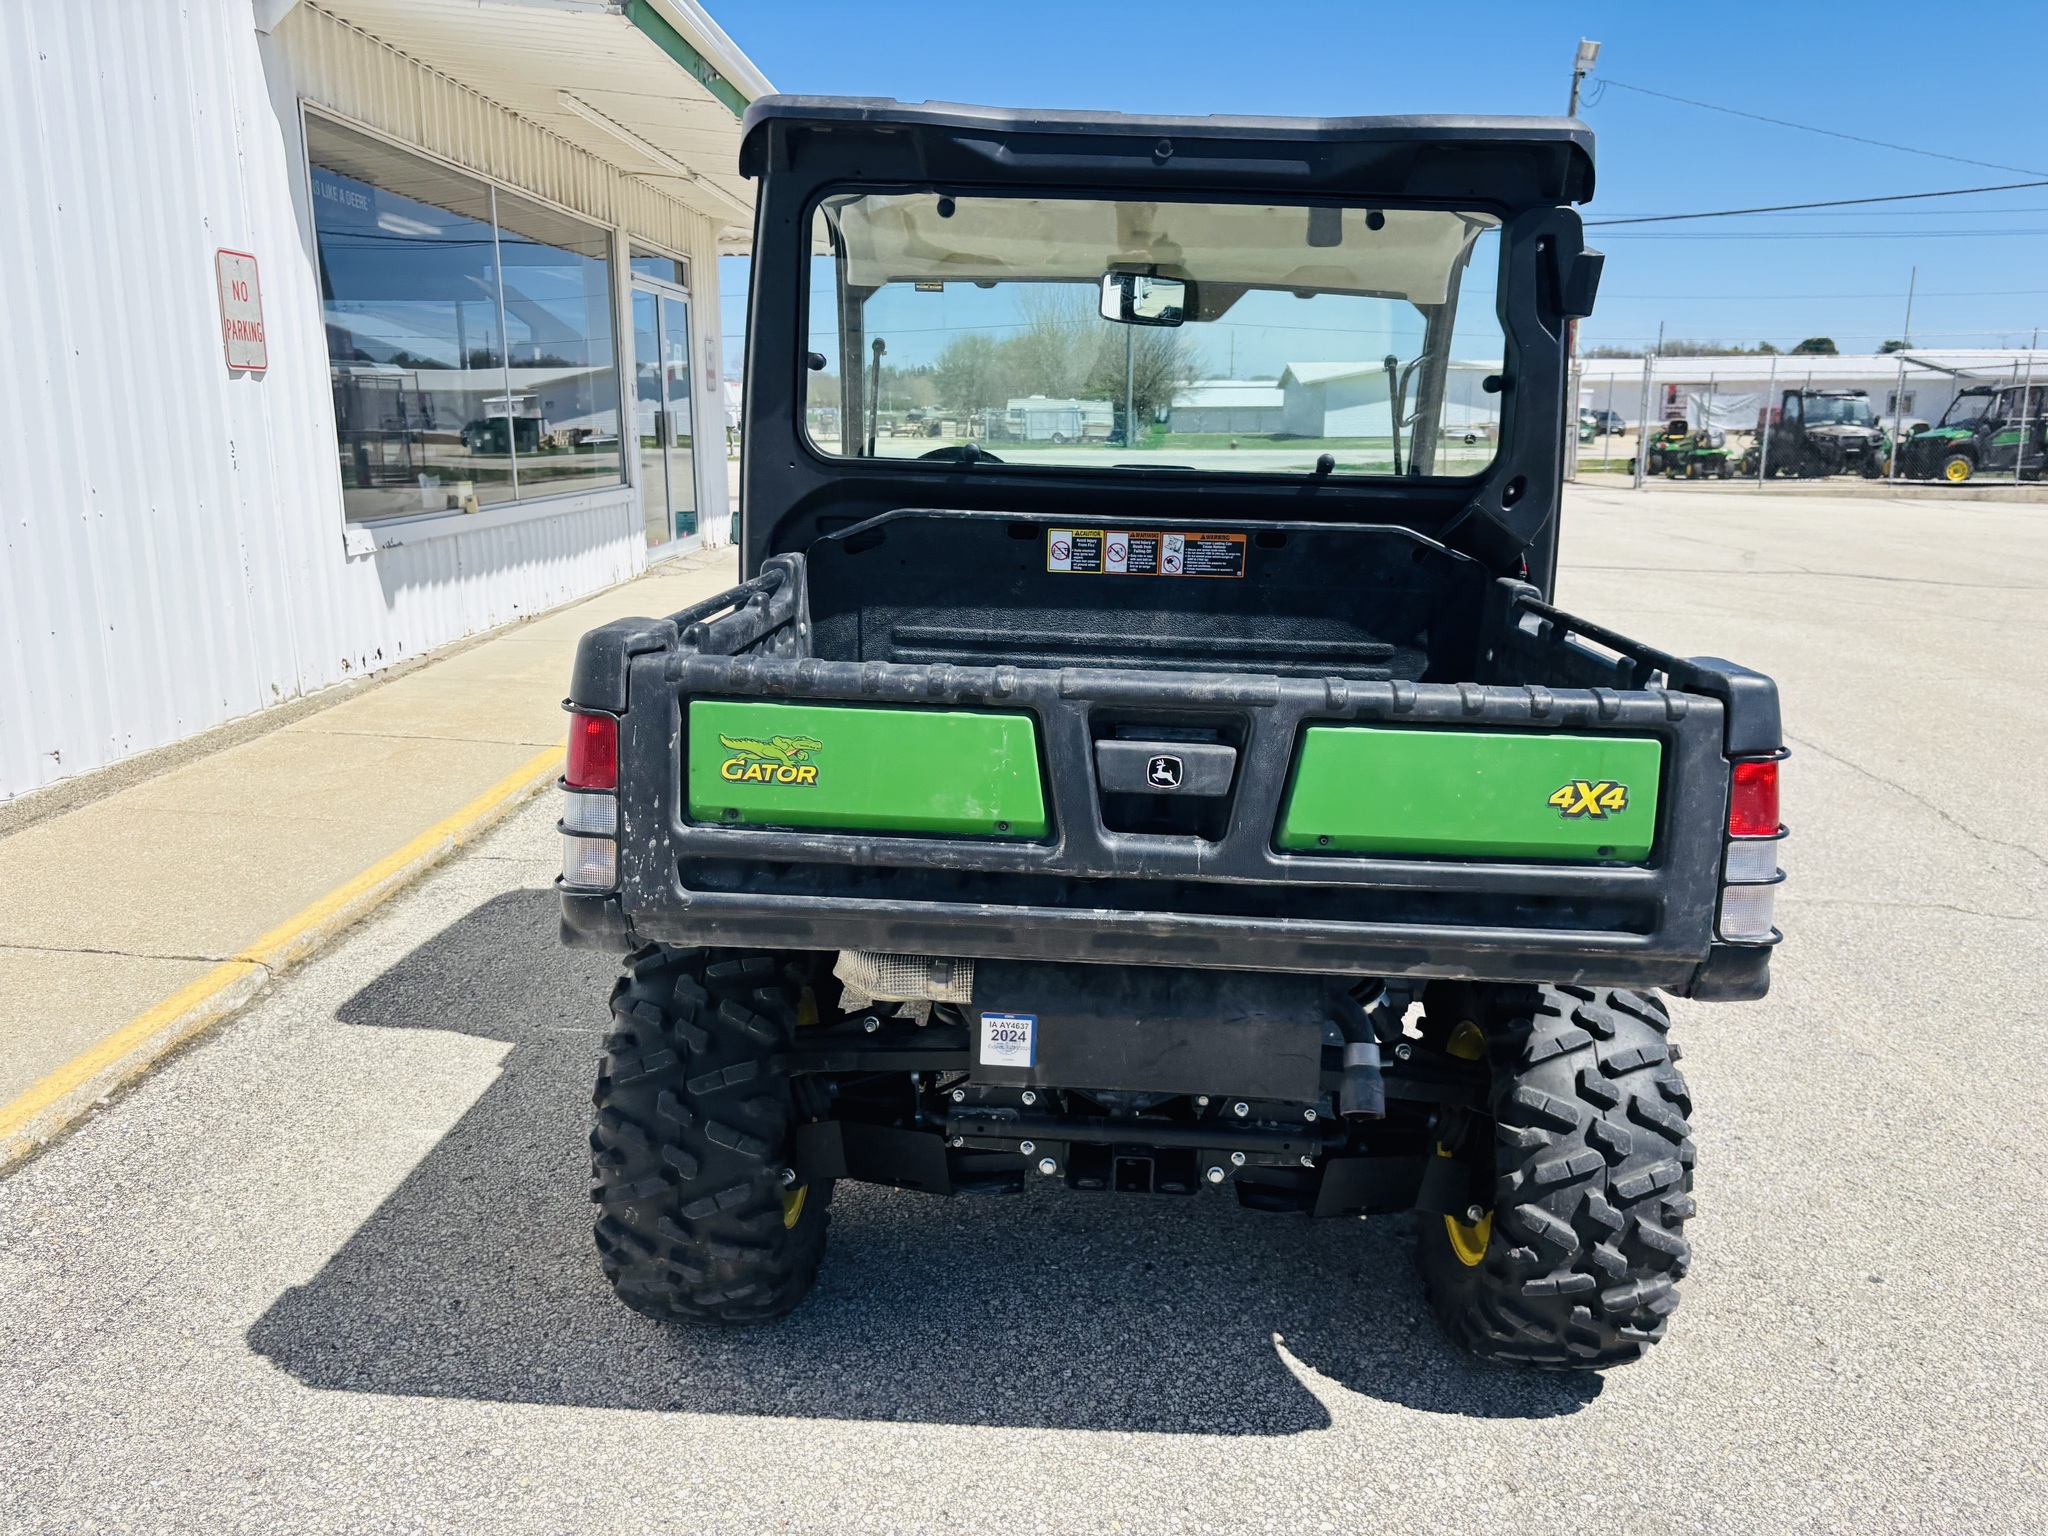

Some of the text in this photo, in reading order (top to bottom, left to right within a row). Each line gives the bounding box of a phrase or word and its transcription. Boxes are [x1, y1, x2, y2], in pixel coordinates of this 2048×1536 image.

[321, 182, 338, 202] LIKE
[339, 188, 345, 203] A
[345, 190, 368, 211] DEERE
[231, 279, 249, 302] NO
[225, 318, 263, 343] PARKING
[721, 758, 817, 784] GATOR
[1548, 782, 1626, 815] 4X4
[991, 1029, 1026, 1042] 2024
